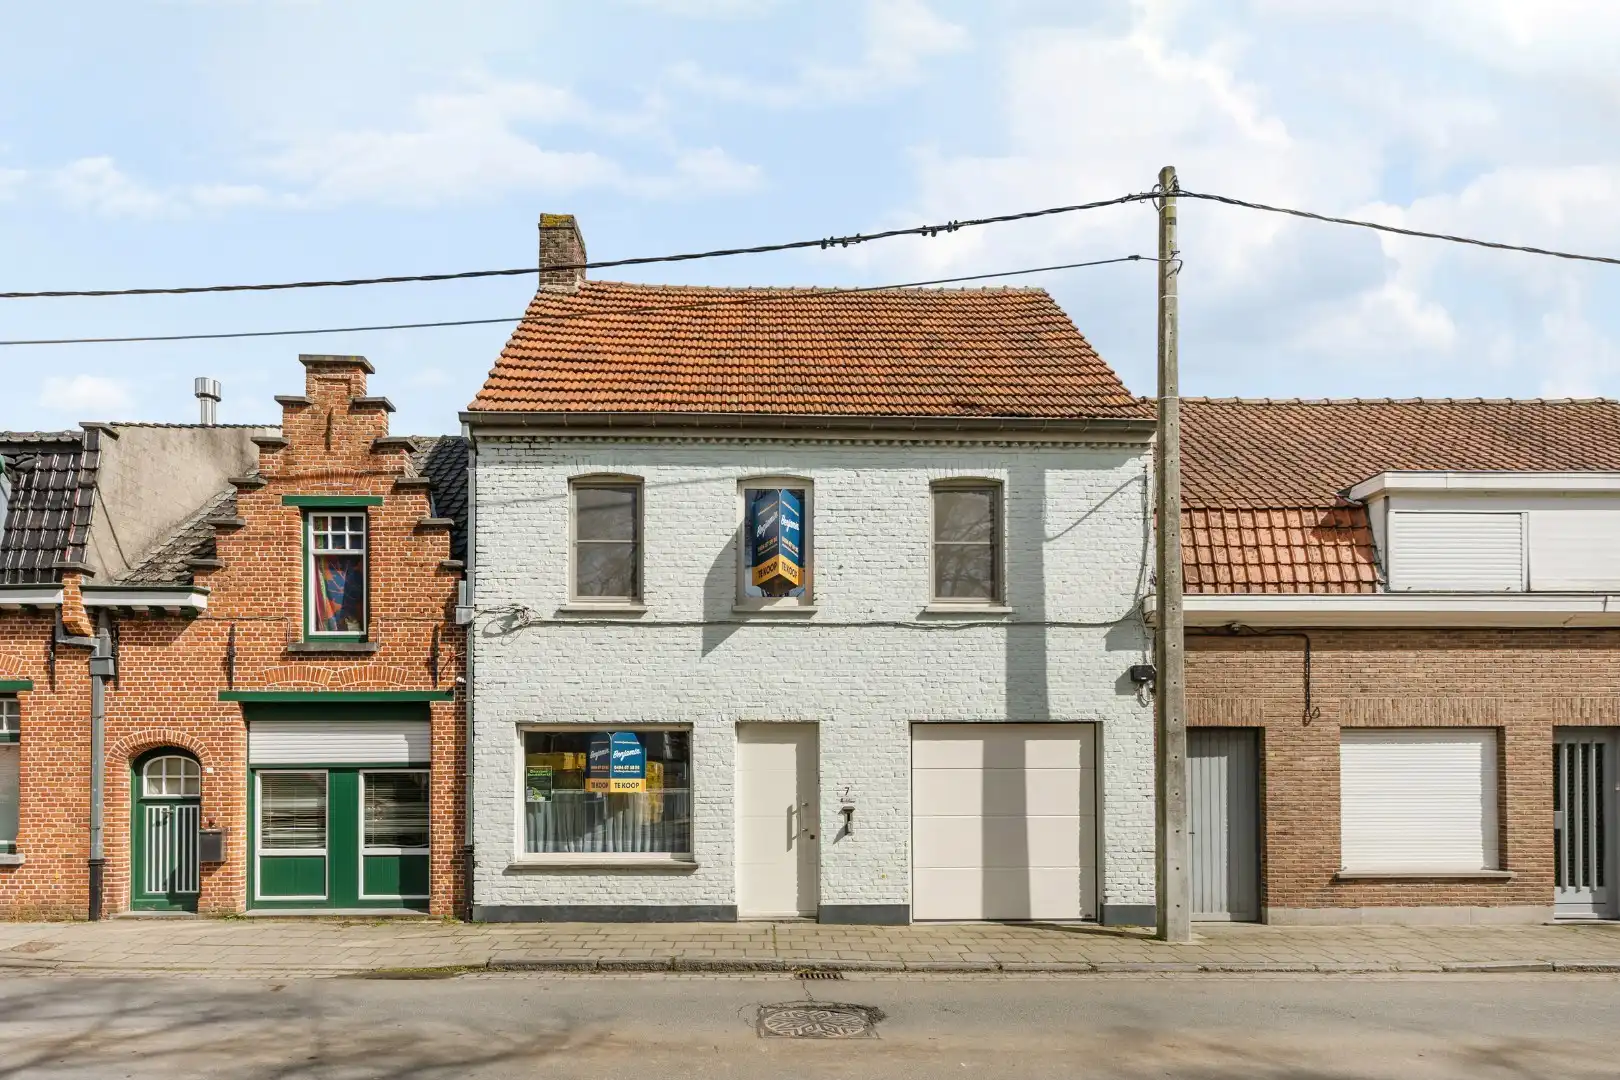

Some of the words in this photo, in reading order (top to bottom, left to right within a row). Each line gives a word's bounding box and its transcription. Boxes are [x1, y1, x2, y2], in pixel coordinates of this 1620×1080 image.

[763, 562, 778, 575] KOOP
[786, 565, 798, 578] KOOP
[612, 748, 642, 761] Benjamin
[844, 787, 850, 796] 7
